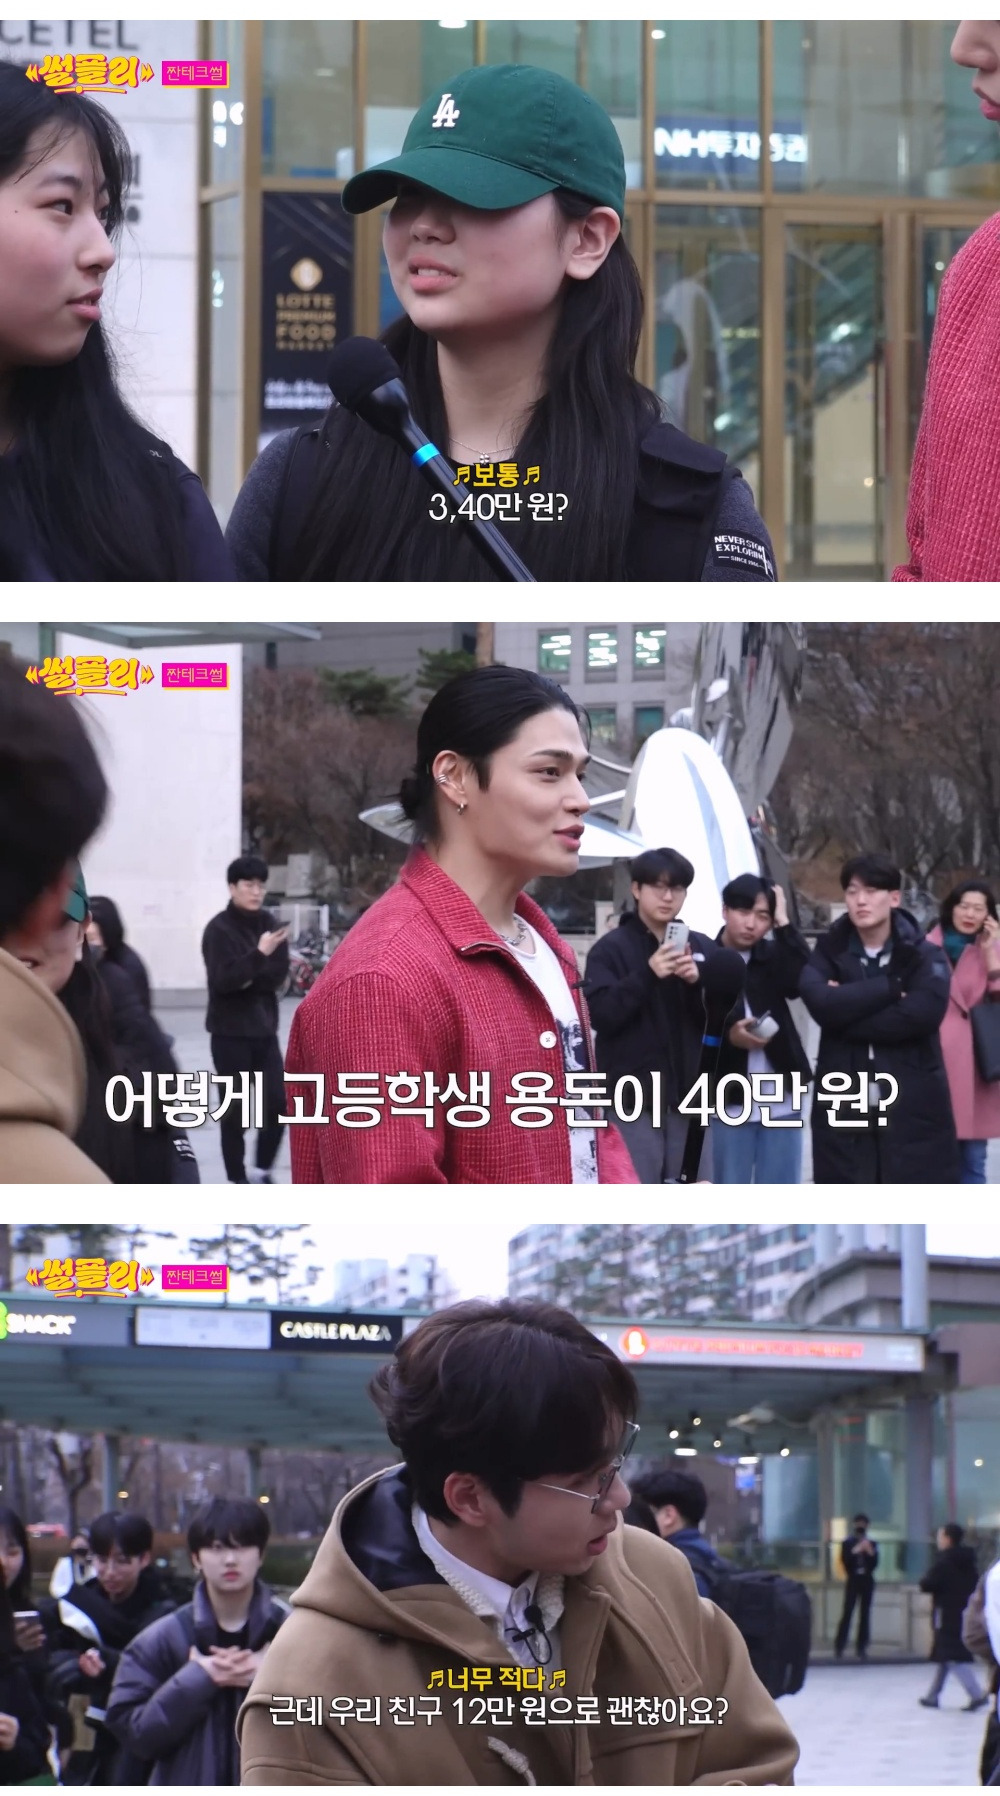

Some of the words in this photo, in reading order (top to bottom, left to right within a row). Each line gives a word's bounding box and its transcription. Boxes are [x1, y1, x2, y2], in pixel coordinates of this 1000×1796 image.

[431, 93, 460, 128] LA
[276, 293, 335, 308] LOTTE
[276, 323, 336, 341] FOOD
[714, 535, 745, 546] NEVER
[280, 1321, 339, 1339] CASTLE
[340, 1323, 392, 1341] PLAZA
